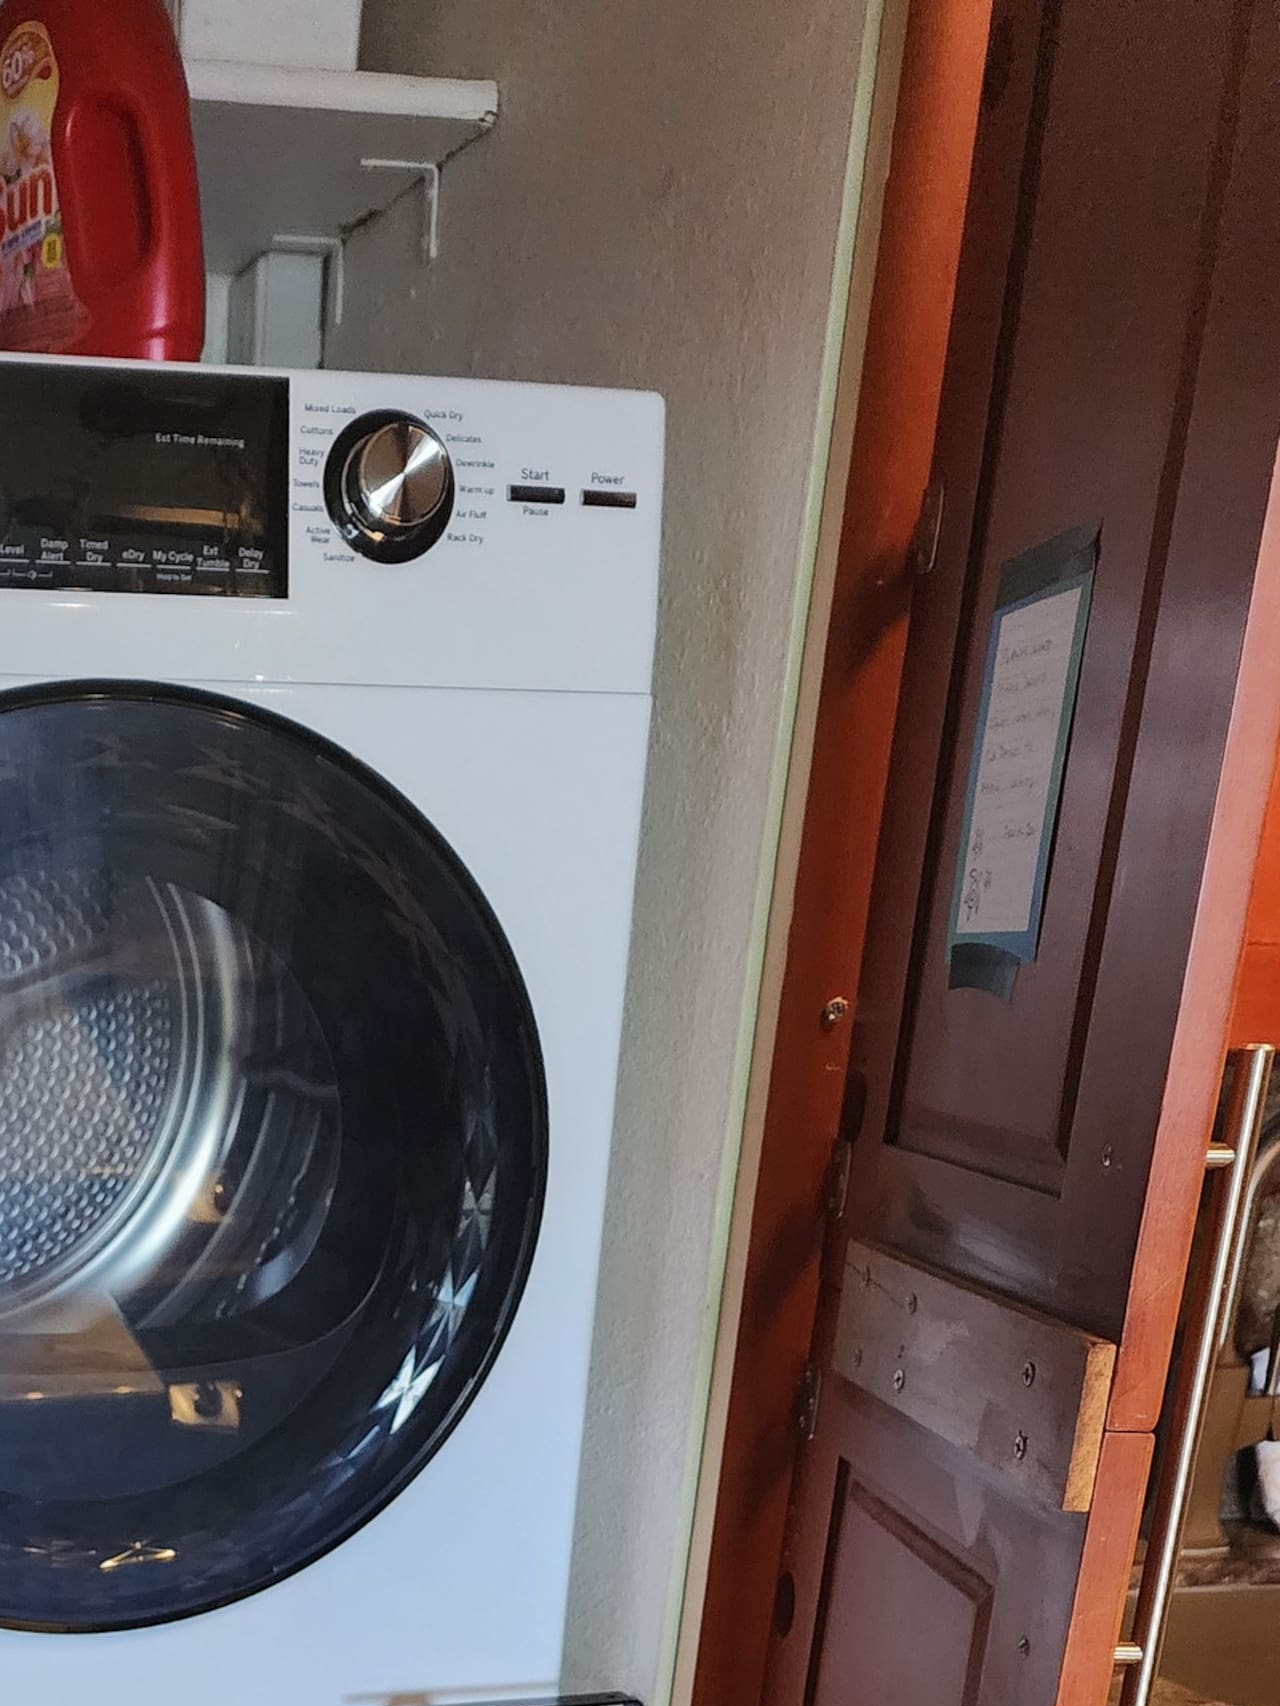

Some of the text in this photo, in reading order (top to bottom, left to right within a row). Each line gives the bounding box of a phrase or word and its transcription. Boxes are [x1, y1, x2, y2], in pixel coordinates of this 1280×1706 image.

[520, 466, 550, 481] Start
[590, 471, 625, 486] Power
[522, 505, 550, 517] Pause
